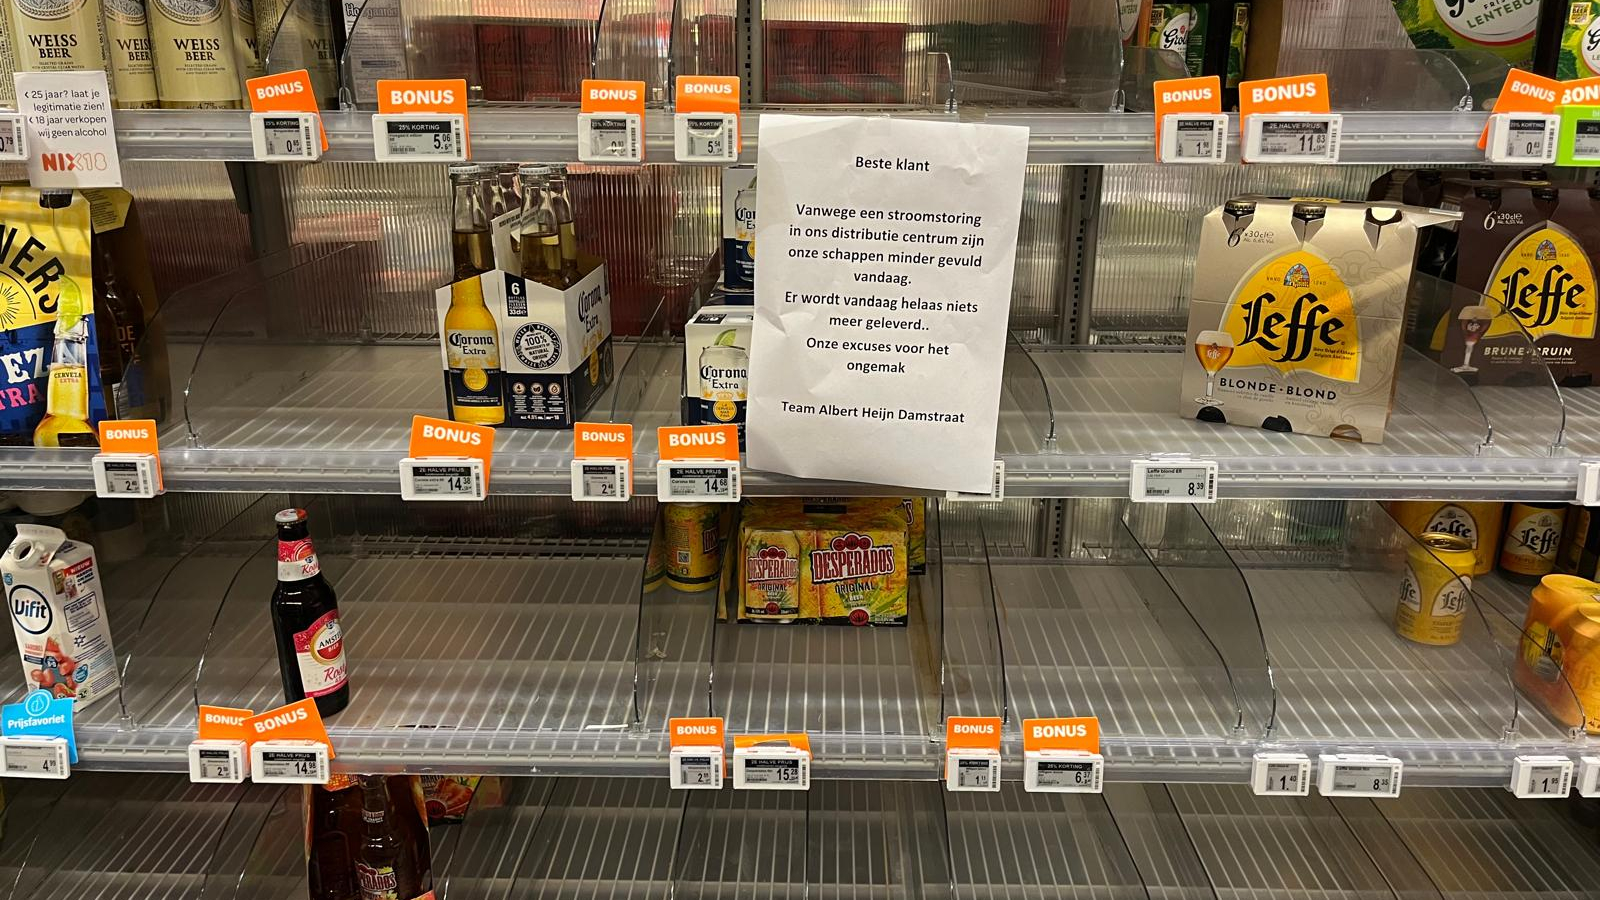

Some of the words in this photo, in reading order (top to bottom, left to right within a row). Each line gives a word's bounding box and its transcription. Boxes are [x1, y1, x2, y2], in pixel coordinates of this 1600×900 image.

[29, 34, 78, 47] WEISS
[117, 38, 150, 51] WEIS
[173, 38, 220, 51] WEISS
[39, 48, 71, 58] BEER
[185, 51, 215, 61] BEER
[32, 90, 43, 98] 25
[45, 90, 68, 100] jaar?
[71, 89, 88, 98] laat
[91, 89, 100, 100] je
[256, 81, 304, 100] BONUS
[590, 89, 637, 100] BONUS
[684, 84, 732, 94] BONUS
[1163, 88, 1212, 103] BONUS
[1252, 82, 1316, 103] BONUS
[1511, 81, 1556, 103] BONUS
[391, 89, 454, 105] BONUS
[34, 103, 81, 113] legitimatie
[84, 103, 105, 111] zien!
[36, 116, 45, 124] 18
[47, 116, 63, 126] jaar
[65, 115, 107, 126] verkopen
[38, 129, 51, 138] wij
[52, 130, 73, 138] geen
[74, 128, 107, 137] alcohol
[42, 153, 107, 172] NIX18
[855, 156, 892, 170] Beste
[896, 157, 930, 172] klant
[796, 203, 856, 219] Vanwege
[860, 209, 885, 220] een
[888, 208, 982, 227] stroomstoring
[1484, 211, 1497, 230] 6
[789, 225, 801, 236] in
[805, 228, 828, 238] ons
[831, 226, 899, 242] distributie
[902, 232, 958, 246] centrum
[962, 233, 984, 249] zijn
[1227, 227, 1245, 248] 6
[788, 248, 819, 259] onze
[822, 247, 884, 264] schappen
[888, 252, 935, 265] minder
[938, 255, 982, 269] gevuld
[853, 271, 912, 287] vandaag.
[511, 282, 520, 296] 6
[1496, 265, 1586, 328] Leffe
[578, 284, 603, 323] Corona
[785, 291, 798, 303] Er
[801, 292, 840, 306] wordt
[844, 294, 897, 311] vandaag
[901, 298, 943, 312] helaas
[946, 300, 978, 313] niets
[585, 314, 599, 333] Extra
[829, 316, 863, 328] meer
[865, 317, 930, 331] geleverd..
[1238, 292, 1345, 363] Leffe
[450, 332, 494, 348] Corona
[525, 334, 547, 347] 100%
[806, 337, 839, 350] Onze
[842, 341, 892, 353] excuses
[895, 344, 924, 355] voor
[927, 343, 949, 355] het
[463, 346, 486, 355] Extra
[1484, 347, 1524, 356] BRUNE
[700, 365, 749, 381] Corona
[847, 359, 906, 374] ongemak
[712, 379, 739, 389] Extra
[1219, 377, 1276, 393] BLONDE
[1286, 385, 1337, 400] BLOND
[781, 401, 815, 414] Team
[819, 404, 858, 418] Albert
[862, 407, 894, 421] Heijn
[898, 408, 965, 424] Damstraat
[106, 429, 149, 439] BONUS
[423, 425, 481, 445] BONUS
[582, 431, 625, 442] BONUS
[669, 432, 726, 446] BONUS
[748, 558, 798, 580] DESPERADOS
[814, 549, 894, 581] DESPERADOS
[758, 583, 787, 591] ORIGINAL
[835, 582, 875, 594] ORIGINAL
[8, 714, 65, 730] Prijsfavoriet
[254, 708, 308, 733] BONUS
[677, 726, 717, 735] BONUS
[953, 725, 994, 734] BONUS
[1033, 725, 1087, 738] BONUS
